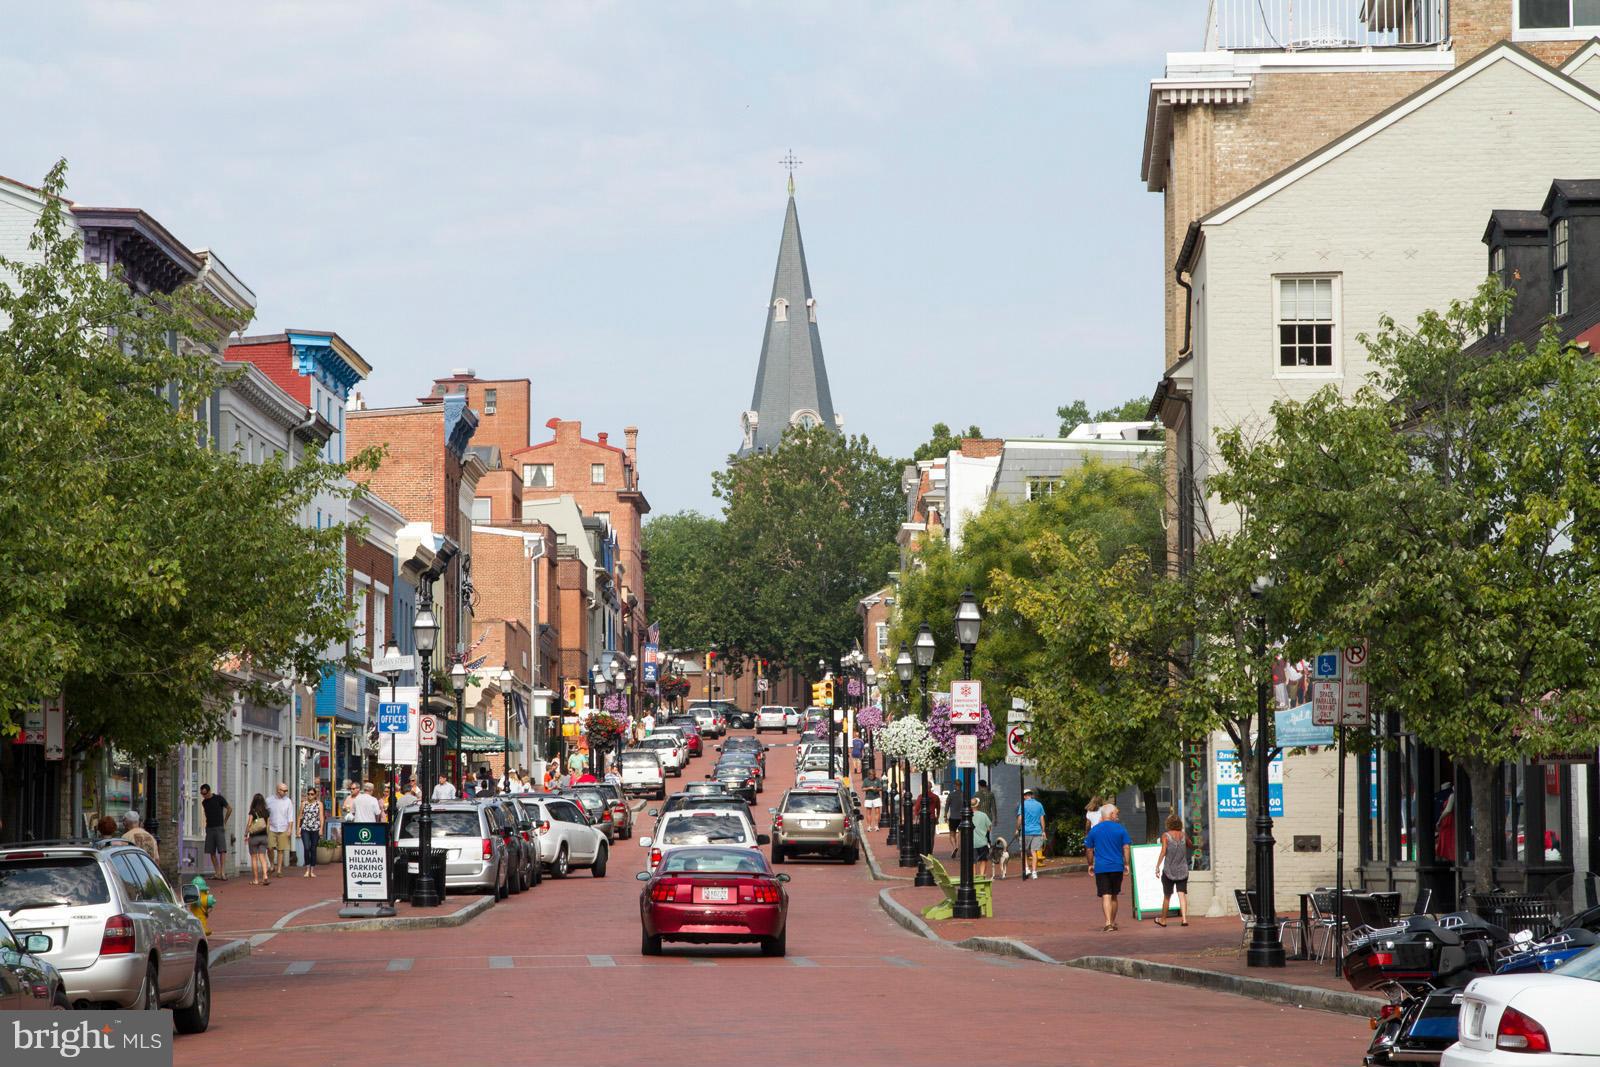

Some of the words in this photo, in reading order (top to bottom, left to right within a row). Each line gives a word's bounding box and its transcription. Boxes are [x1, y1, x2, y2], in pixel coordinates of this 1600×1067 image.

[386, 705, 401, 714] CITY
[380, 715, 407, 724] OFFICES
[351, 871, 383, 879] GARAGE
